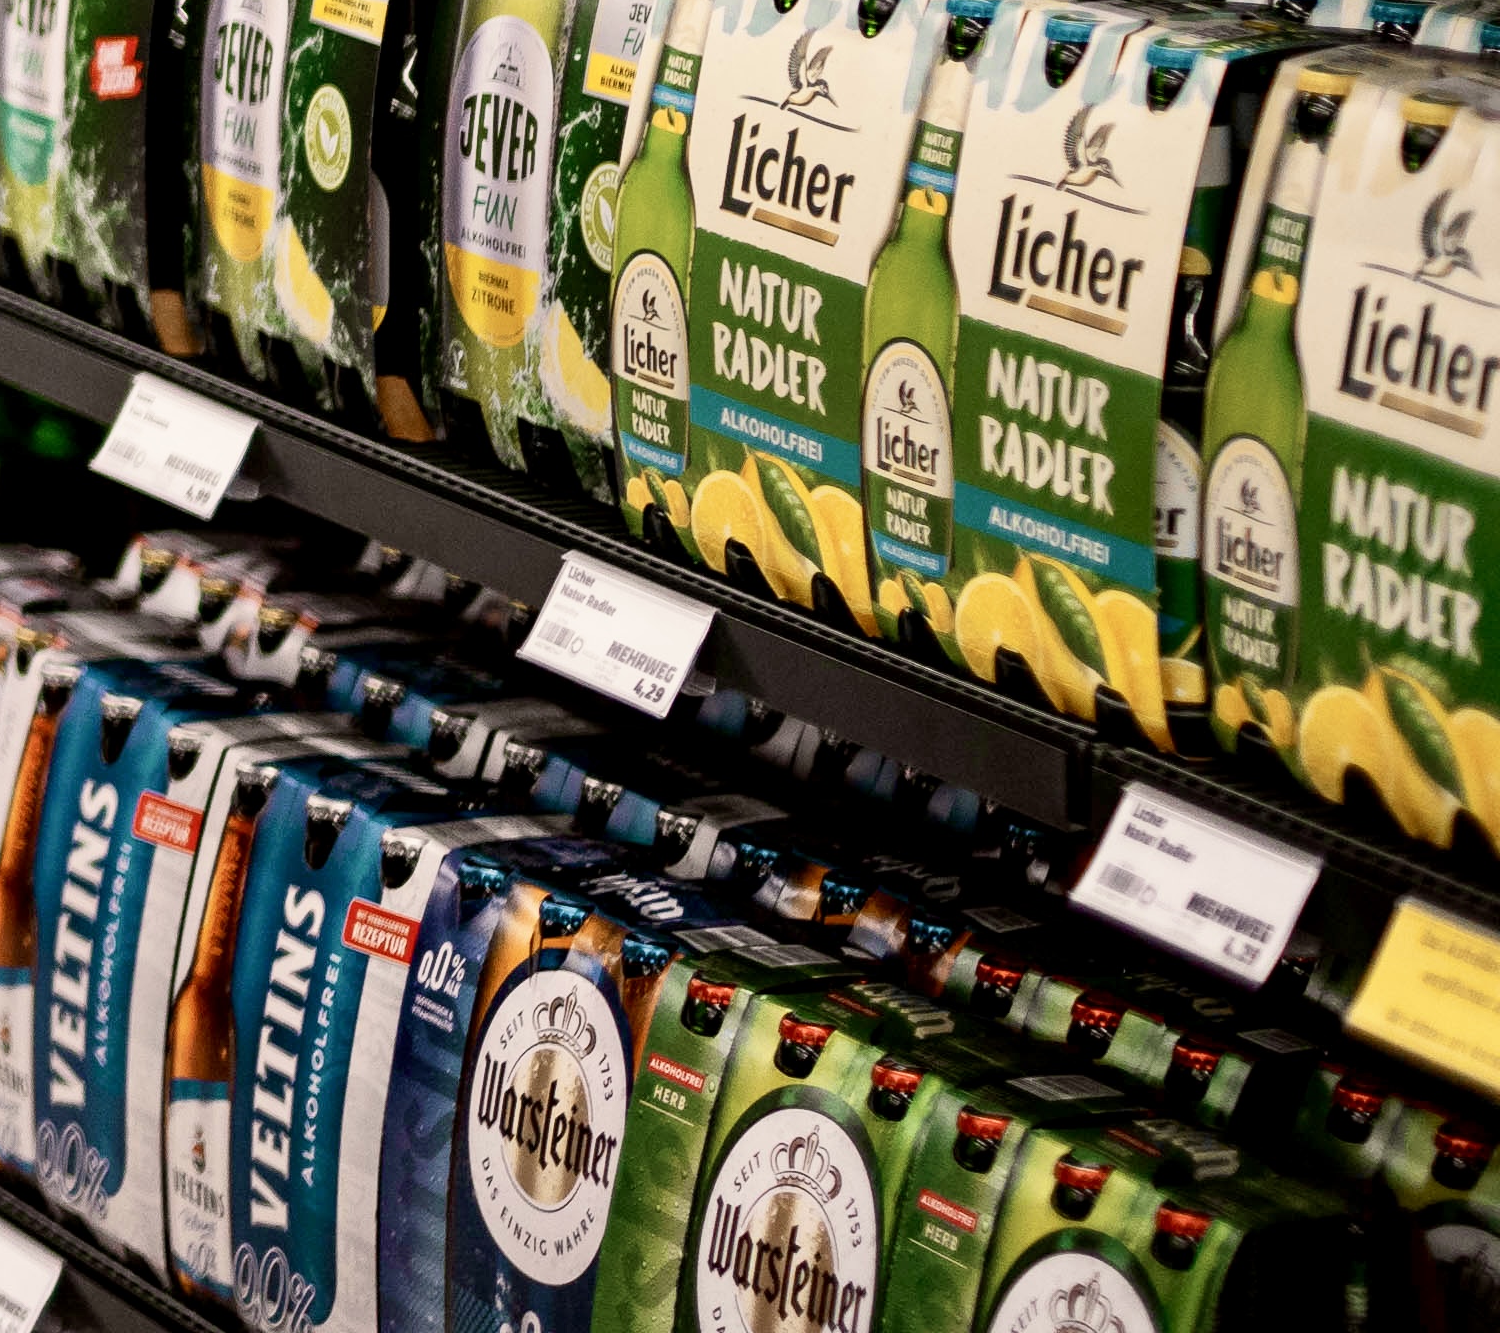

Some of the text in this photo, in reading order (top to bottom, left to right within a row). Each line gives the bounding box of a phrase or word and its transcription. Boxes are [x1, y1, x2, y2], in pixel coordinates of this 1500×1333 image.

[214, 21, 273, 107] JEVER
[664, 69, 692, 89] RADLER
[667, 54, 694, 73] NATUR
[460, 92, 538, 183] JEVER
[720, 112, 855, 224] Licher
[472, 184, 517, 232] FUN
[462, 228, 527, 259] ALKOHOLFREI
[987, 193, 1144, 312] Licher
[471, 286, 516, 316] ZITRONE
[719, 257, 822, 346] NATUR
[624, 322, 678, 379] Licher
[713, 322, 826, 415] RADLER
[1340, 282, 1500, 413] Licher
[633, 389, 666, 421] NATUR
[987, 348, 1110, 442] NATUR
[633, 411, 671, 447] RADLER
[721, 405, 822, 462] ALKOHOLFREI
[877, 417, 939, 475] Licher
[981, 414, 1114, 516] RADLER
[886, 510, 930, 547] RADLER
[887, 486, 927, 519] NATUR
[1332, 463, 1475, 577] NATUR
[989, 507, 1110, 566] ALKOHOLFREI
[1218, 517, 1284, 581] Licher
[560, 584, 617, 617] Natur Radler
[568, 566, 596, 587] Licher
[1323, 542, 1480, 664] RADLER
[606, 640, 677, 683] MEHRWEG
[633, 678, 666, 703] 4,29
[50, 778, 118, 1110] VELTINS
[94, 842, 132, 1067] ALKOHOLFREI
[351, 920, 406, 958] REZEPTUR
[417, 941, 466, 992] 0,0%
[250, 884, 325, 1232] VELTINS
[301, 953, 342, 1188] ALKOHOLFREI
[500, 1009, 613, 1101] SEIT 1753
[650, 1057, 703, 1089] ALKOHOLFREI
[478, 1051, 617, 1188] Warsteiner
[653, 1085, 686, 1111] HERB
[482, 1156, 595, 1256] DAS EINZIG WAHRE
[733, 1152, 862, 1249] SEIT 1753
[708, 1195, 867, 1333] Warsteiner
[925, 1224, 958, 1252] HERB
